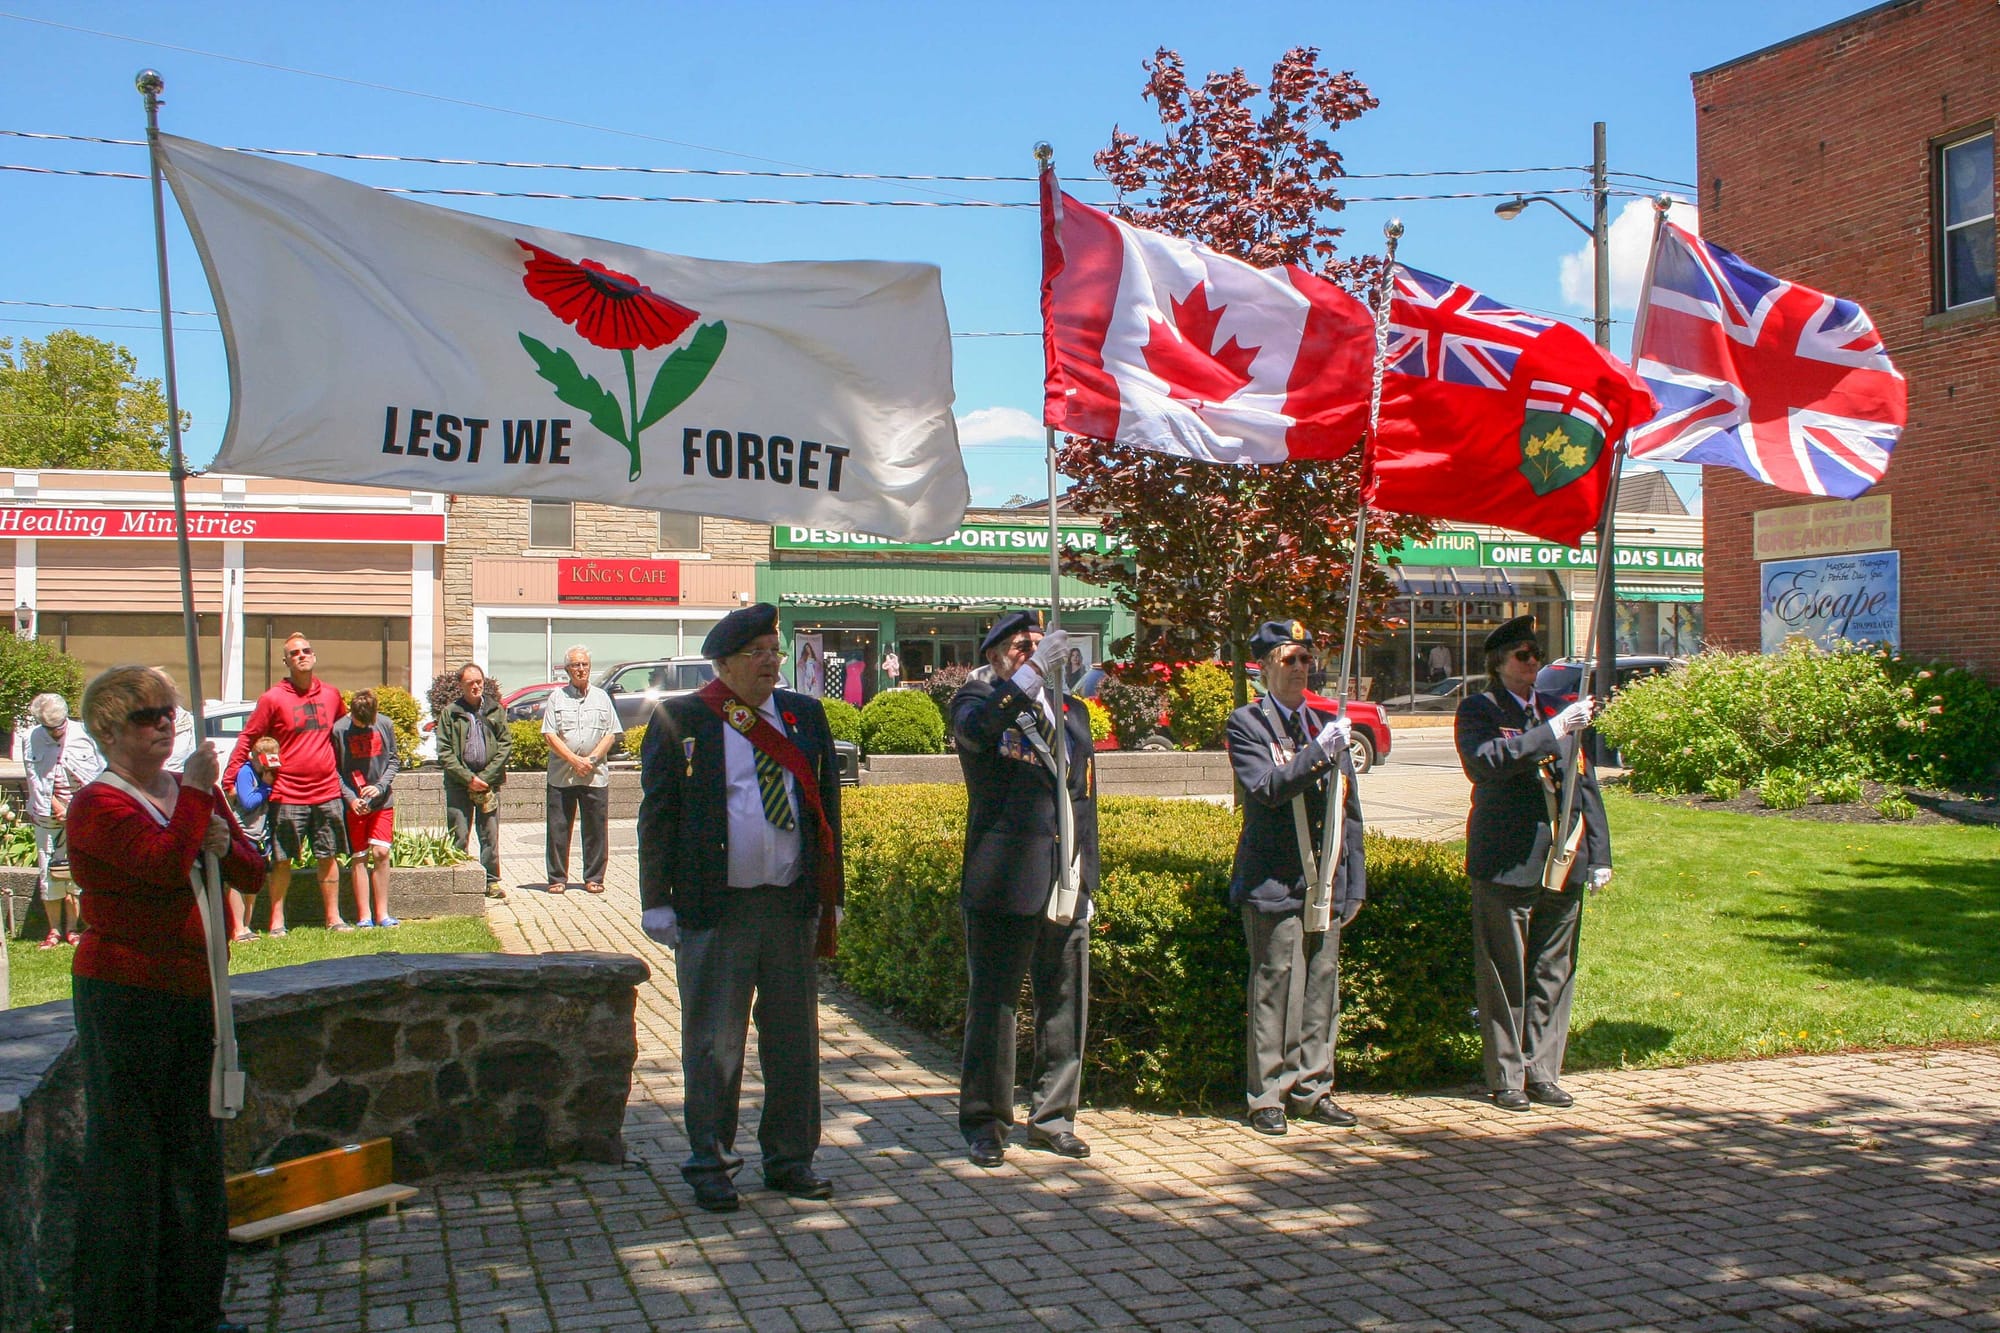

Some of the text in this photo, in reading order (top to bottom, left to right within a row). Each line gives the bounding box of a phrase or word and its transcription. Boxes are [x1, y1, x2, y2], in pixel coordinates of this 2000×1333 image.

[381, 406, 851, 492] LEST WE FORGET
[0, 509, 257, 537] Healing Minstries
[1757, 520, 1887, 552] BREAKFAST
[790, 526, 910, 545] DESIG
[930, 529, 1096, 549] PORTSWAR
[1491, 547, 1532, 564] ONE
[1537, 548, 1563, 564] OF
[1567, 549, 1658, 566] CADA'S
[571, 566, 668, 584] KING'S CAFE
[1767, 570, 1887, 638] Escape
